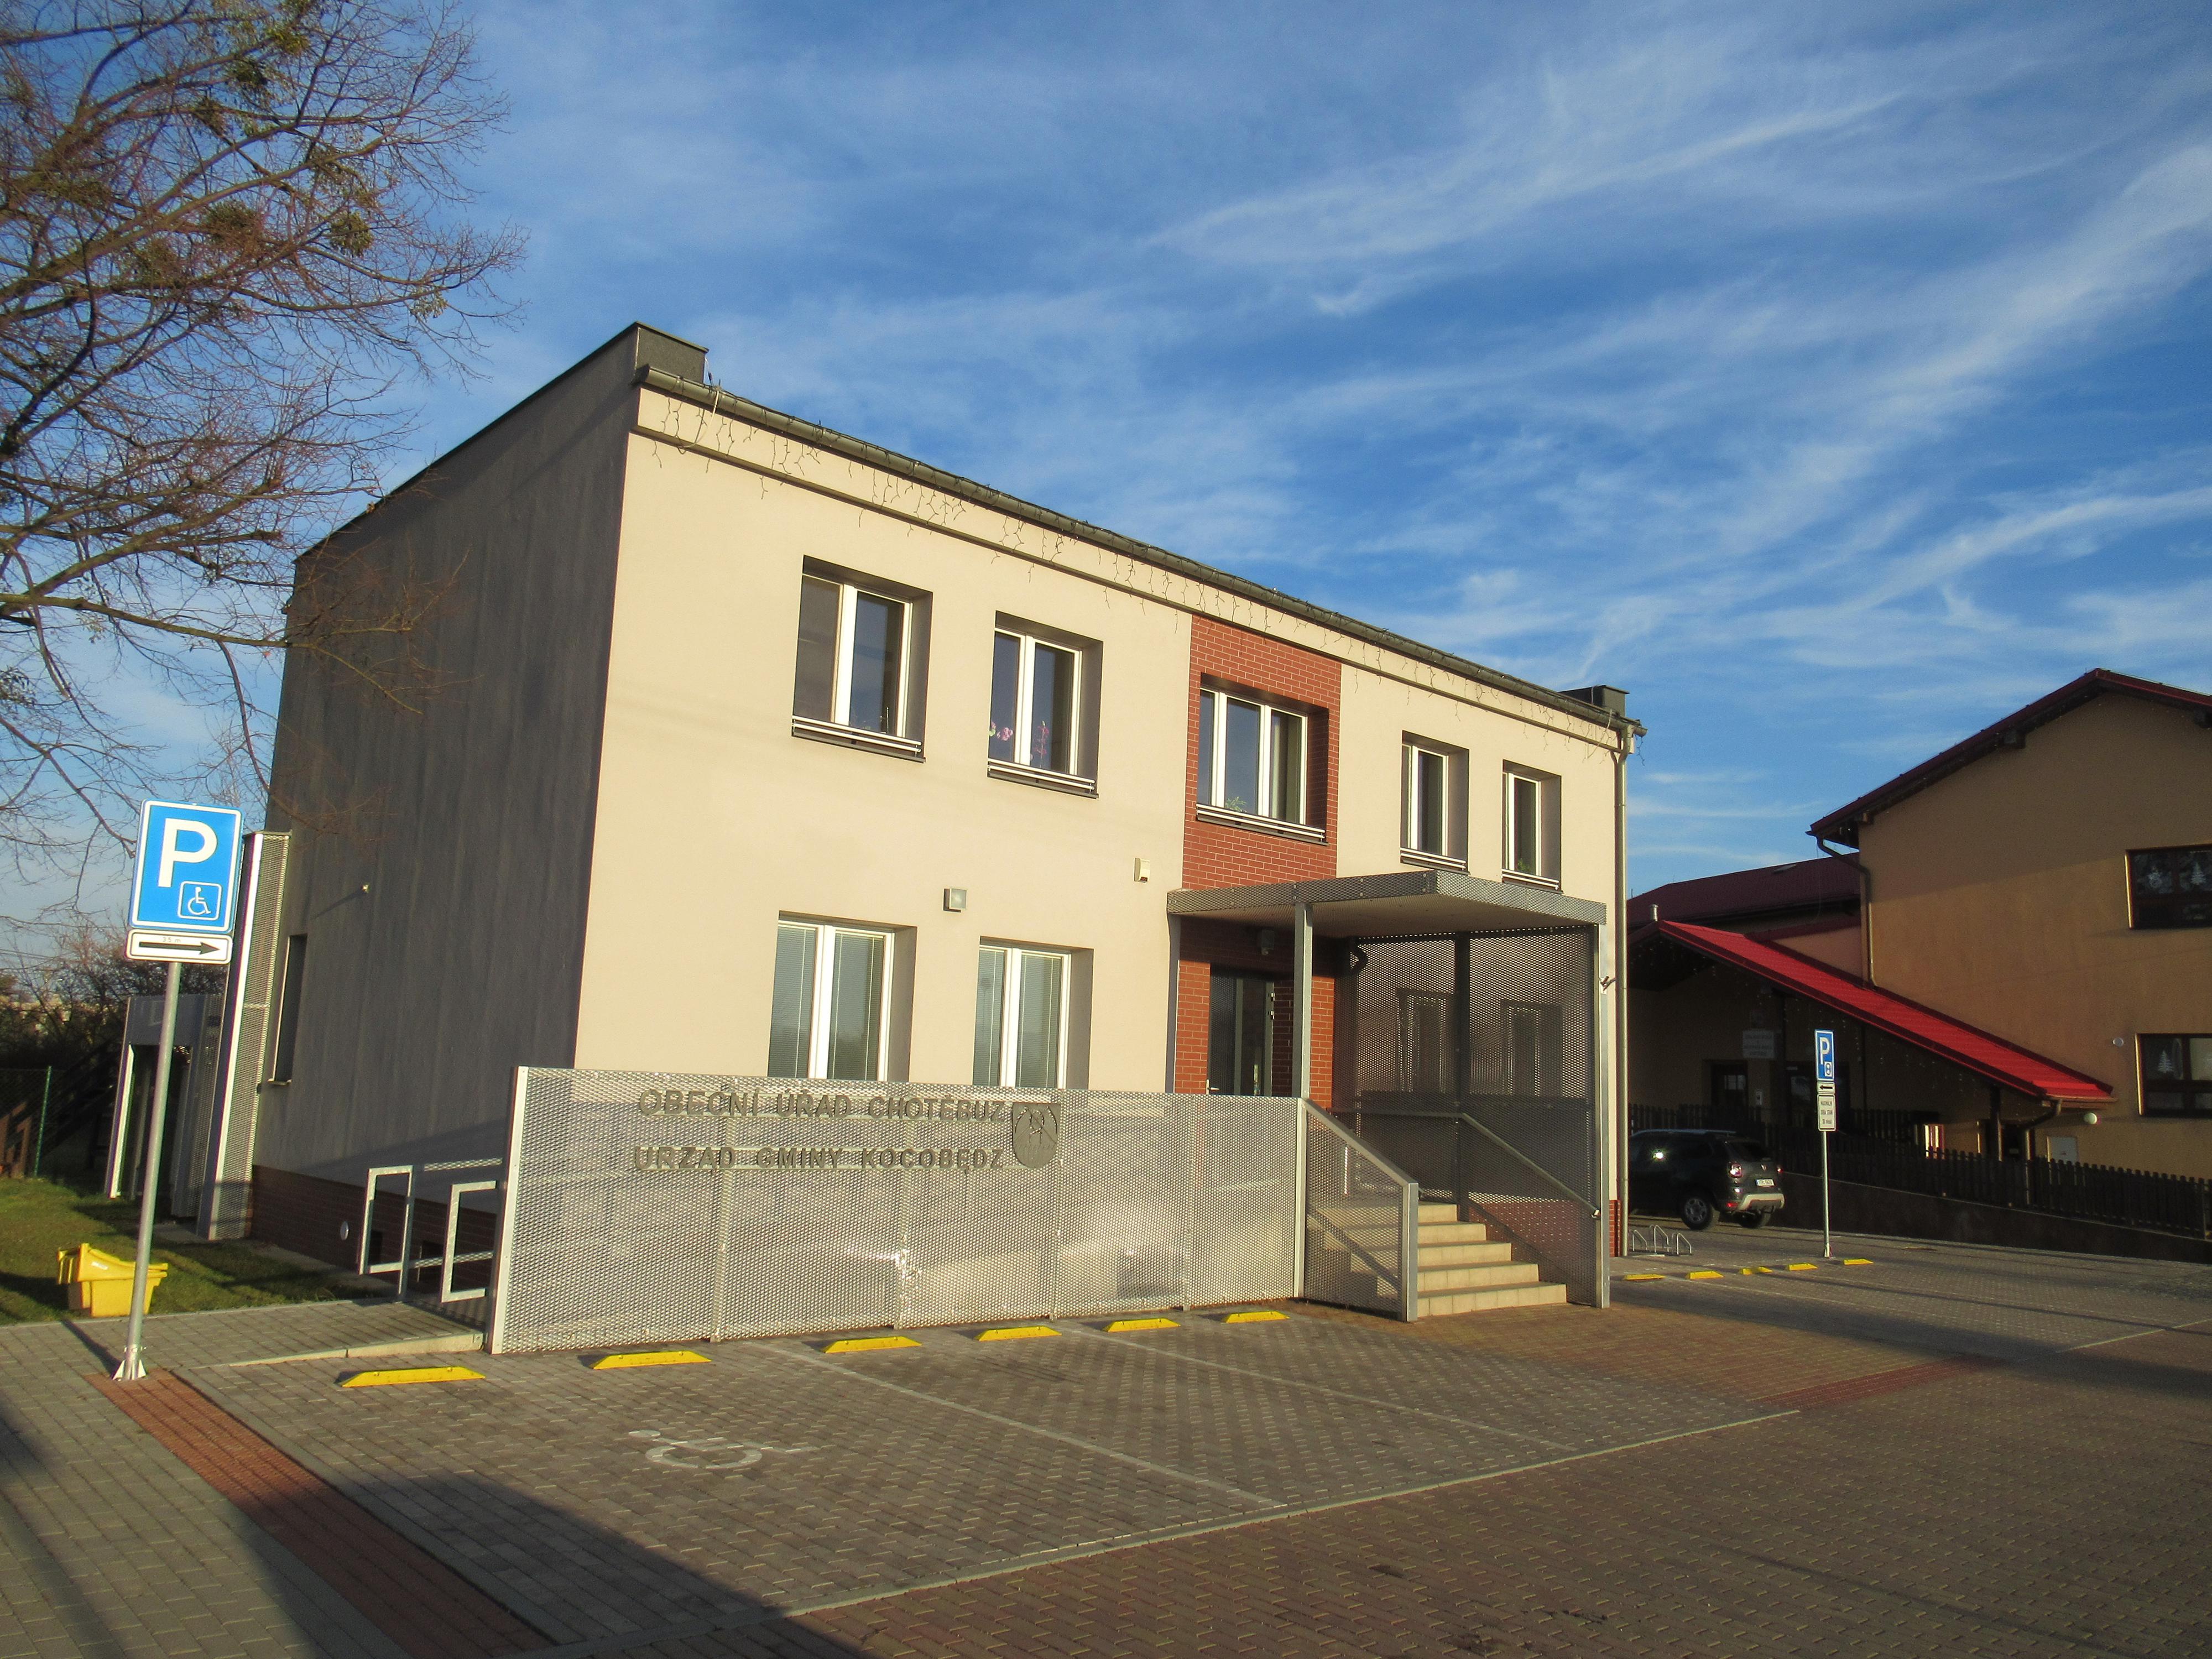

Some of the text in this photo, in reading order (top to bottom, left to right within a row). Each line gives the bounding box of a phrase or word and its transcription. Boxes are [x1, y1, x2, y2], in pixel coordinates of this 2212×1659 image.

[157, 817, 218, 888] P
[1819, 1036, 1830, 1065] P
[639, 1087, 760, 1117] OBECNÍ
[757, 1146, 843, 1170] GMINY
